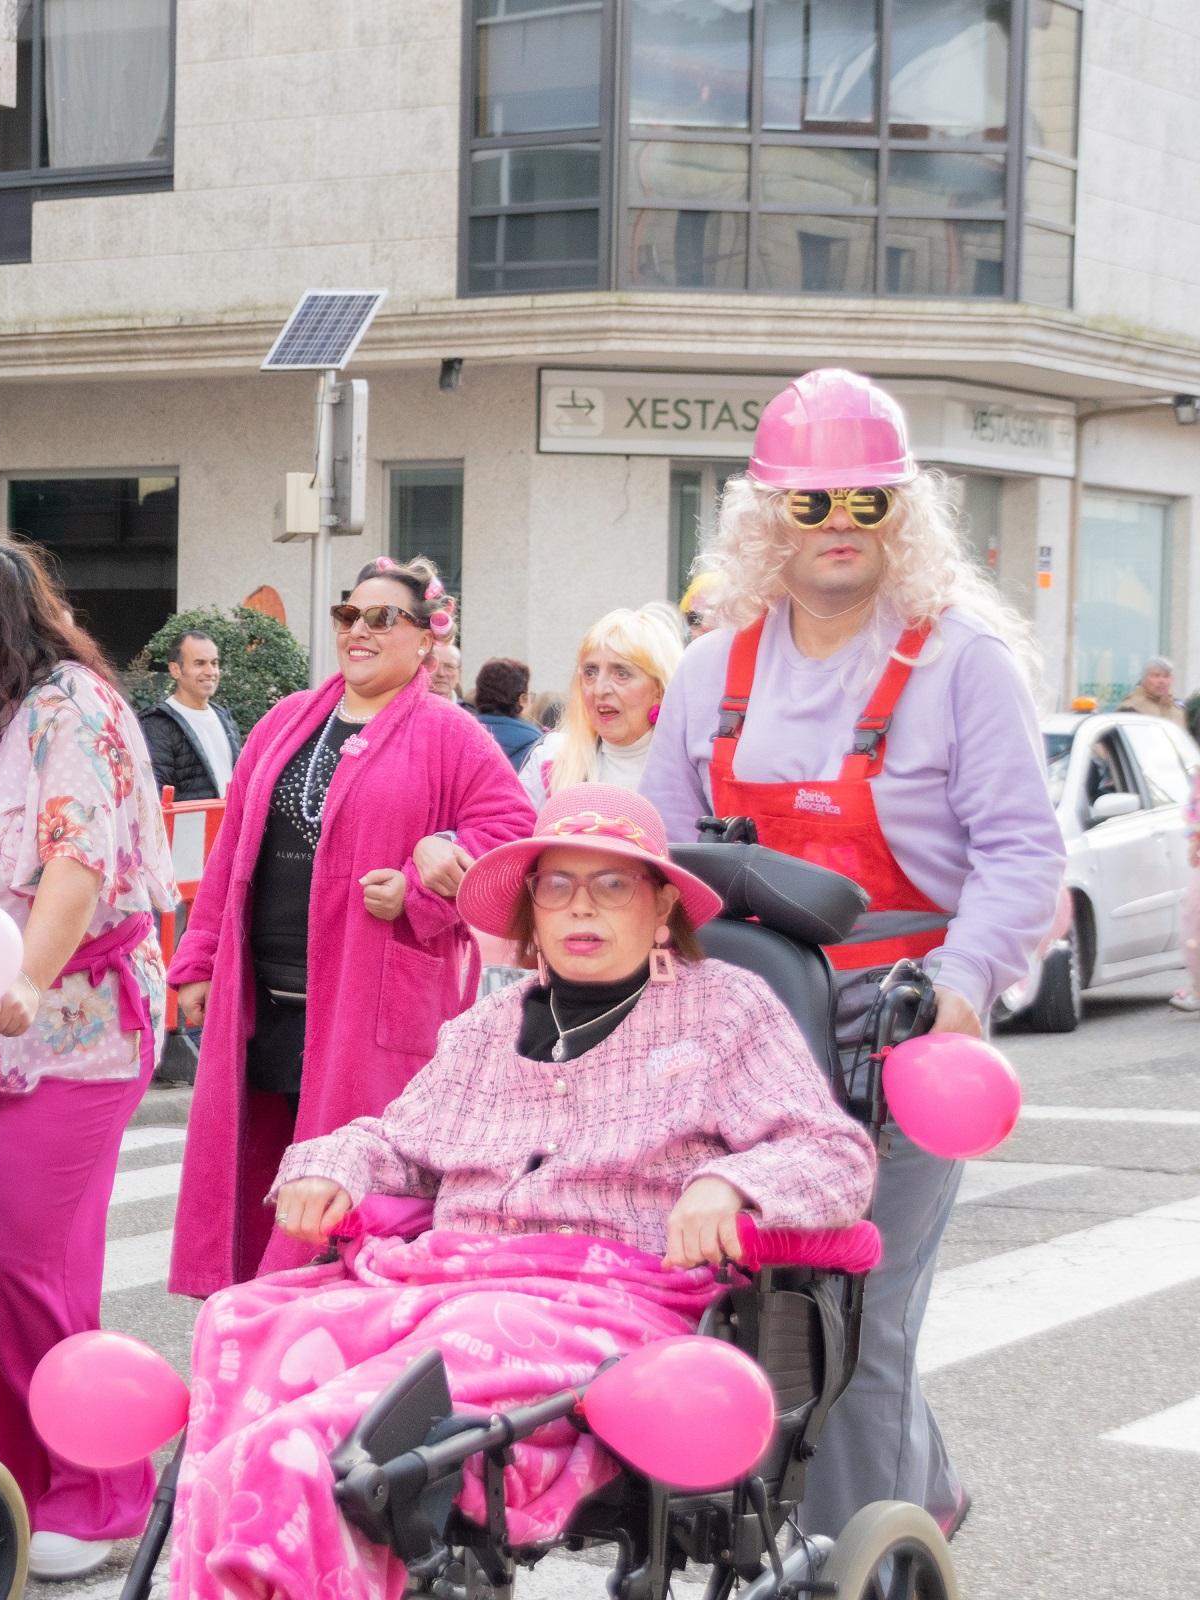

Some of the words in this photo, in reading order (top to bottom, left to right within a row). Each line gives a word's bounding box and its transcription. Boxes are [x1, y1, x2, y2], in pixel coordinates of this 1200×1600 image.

[625, 397, 769, 432] XESTAS
[798, 788, 831, 805] Barbie
[275, 851, 313, 860] ALWAYS
[218, 1338, 240, 1382] GOOD
